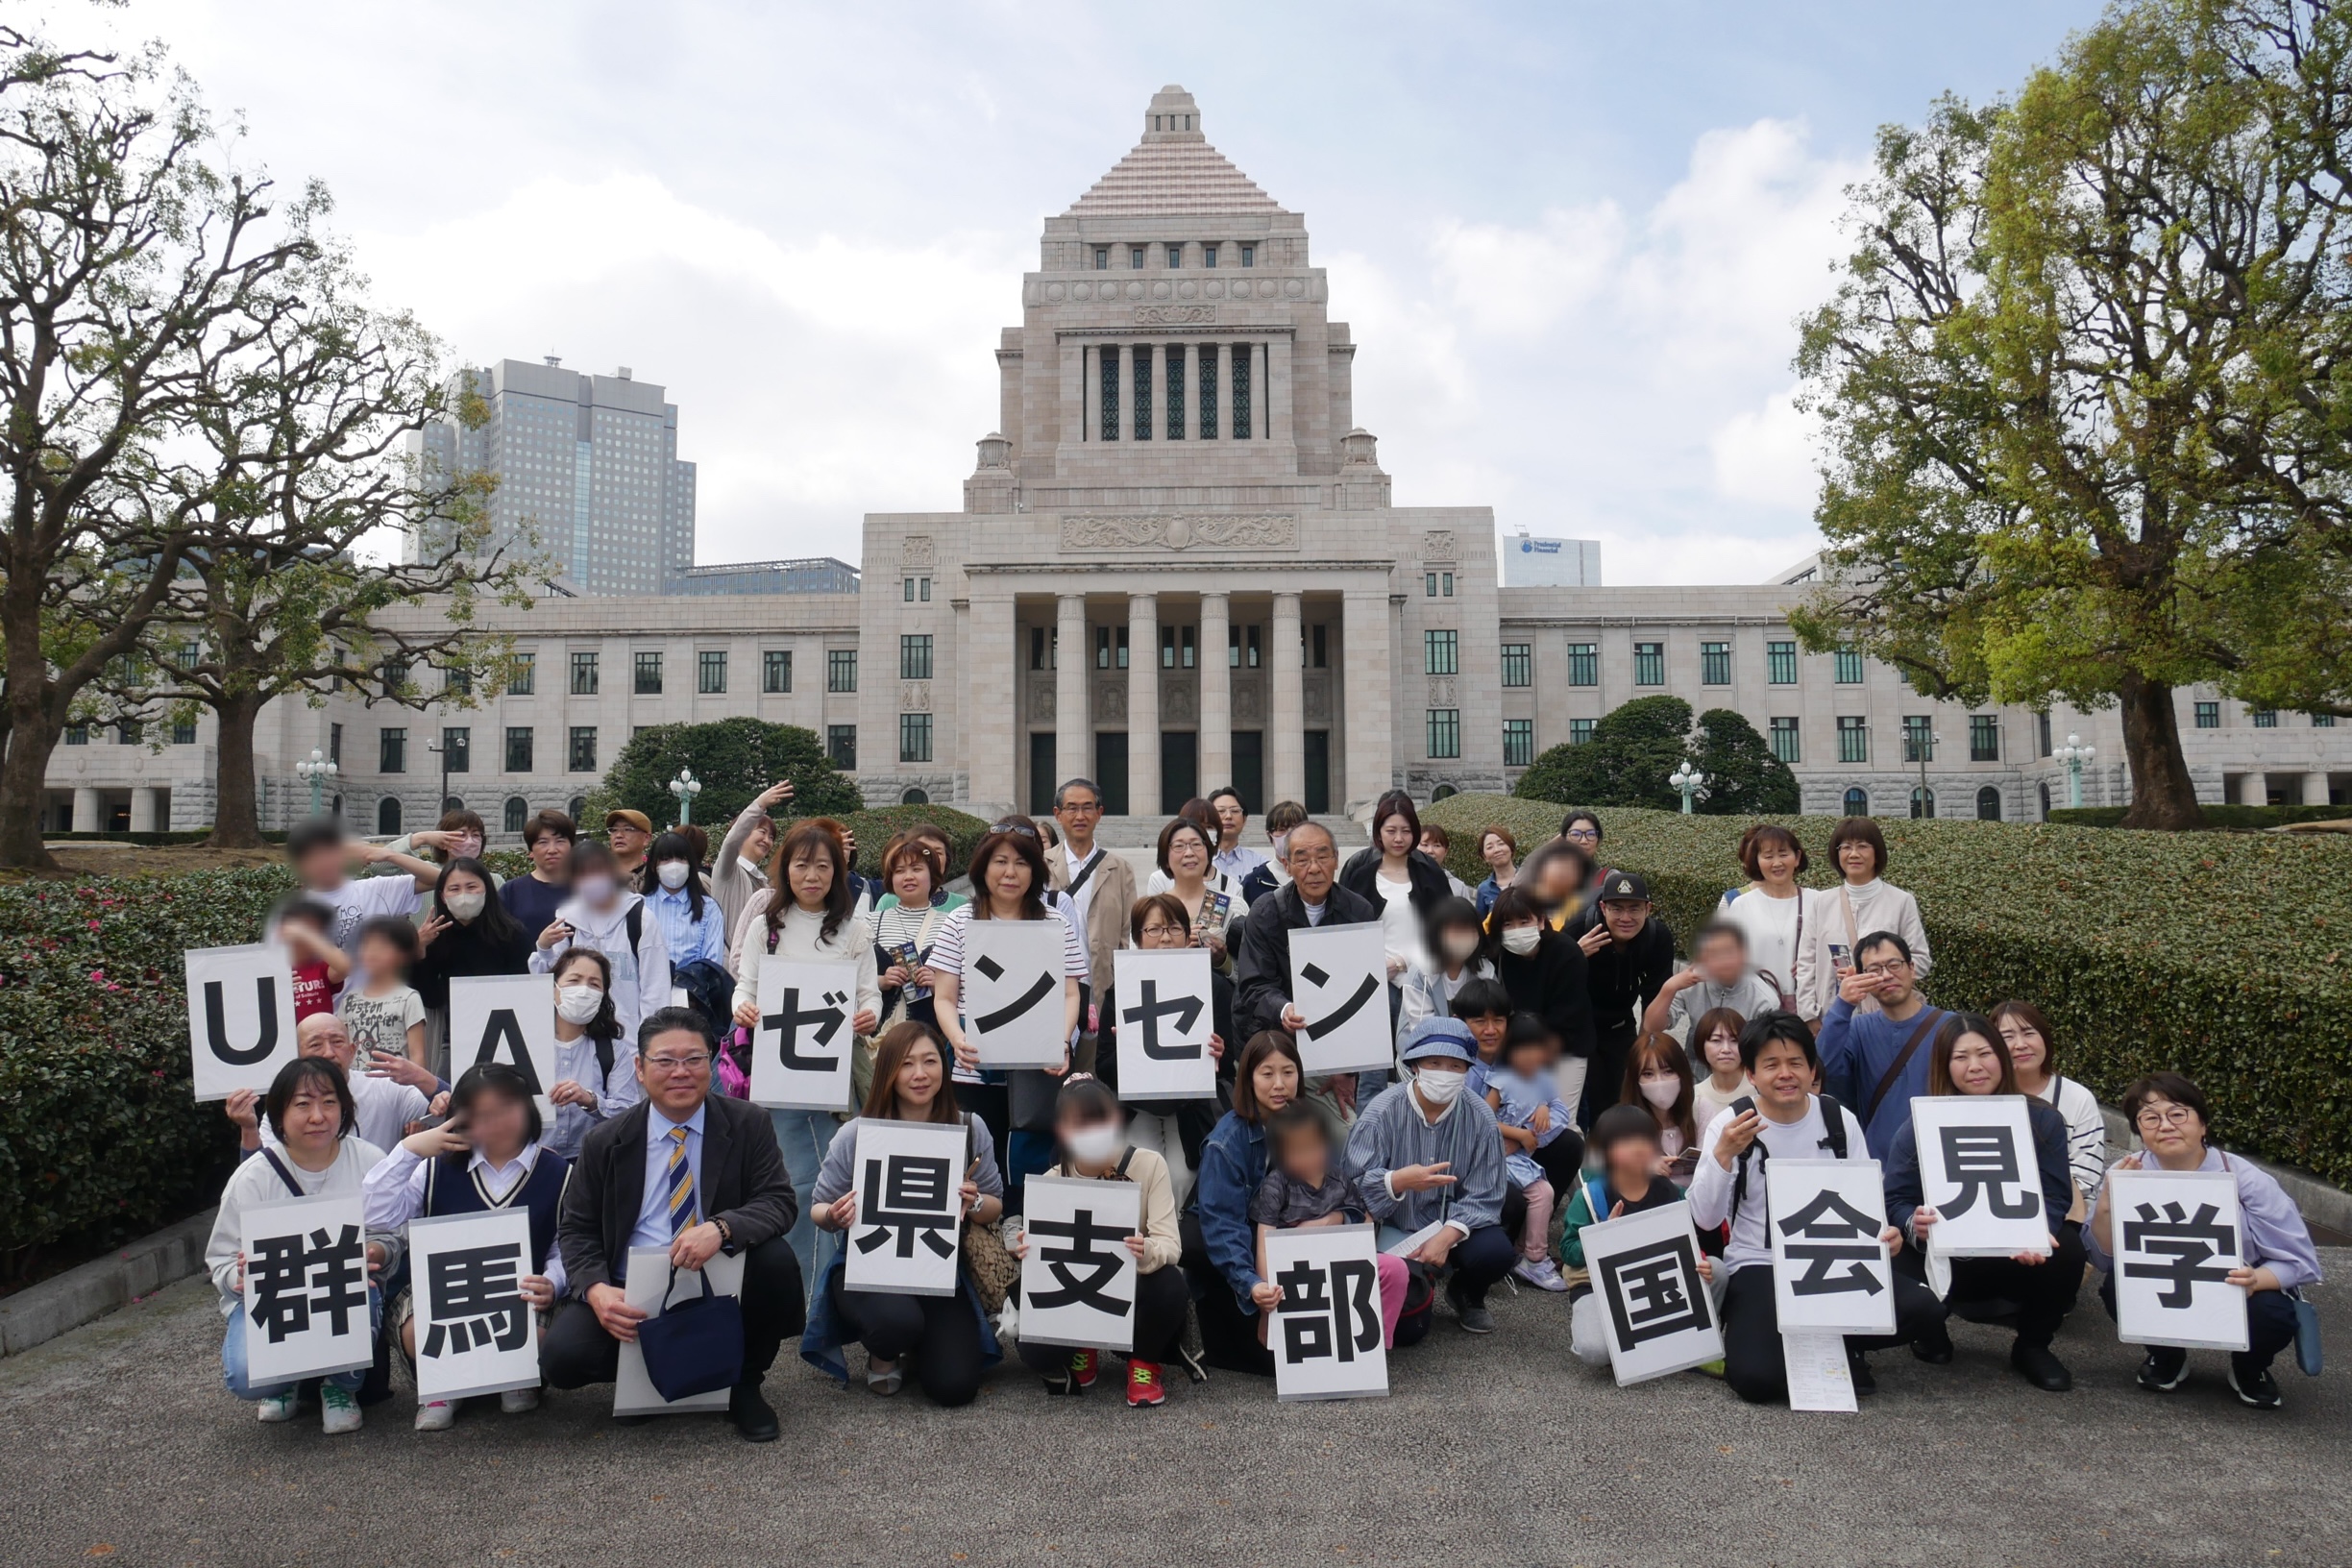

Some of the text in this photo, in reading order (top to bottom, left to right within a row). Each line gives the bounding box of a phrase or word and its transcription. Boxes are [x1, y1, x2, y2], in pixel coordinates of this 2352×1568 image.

[204, 976, 279, 1066] U
[763, 989, 848, 1072] ゼ
[974, 954, 1056, 1035] ン
[1122, 980, 1204, 1061] セ
[1301, 962, 1380, 1041] ン
[475, 1009, 543, 1095] A
[855, 1156, 955, 1260] 県
[1936, 1126, 2039, 1220] 見
[248, 1224, 367, 1344] 群
[1027, 1210, 1136, 1316] 支
[1597, 1234, 1712, 1353] 国
[1777, 1189, 1884, 1296] 会
[2123, 1201, 2236, 1309] 学
[422, 1243, 529, 1360] 馬
[1277, 1260, 1381, 1364] 部
